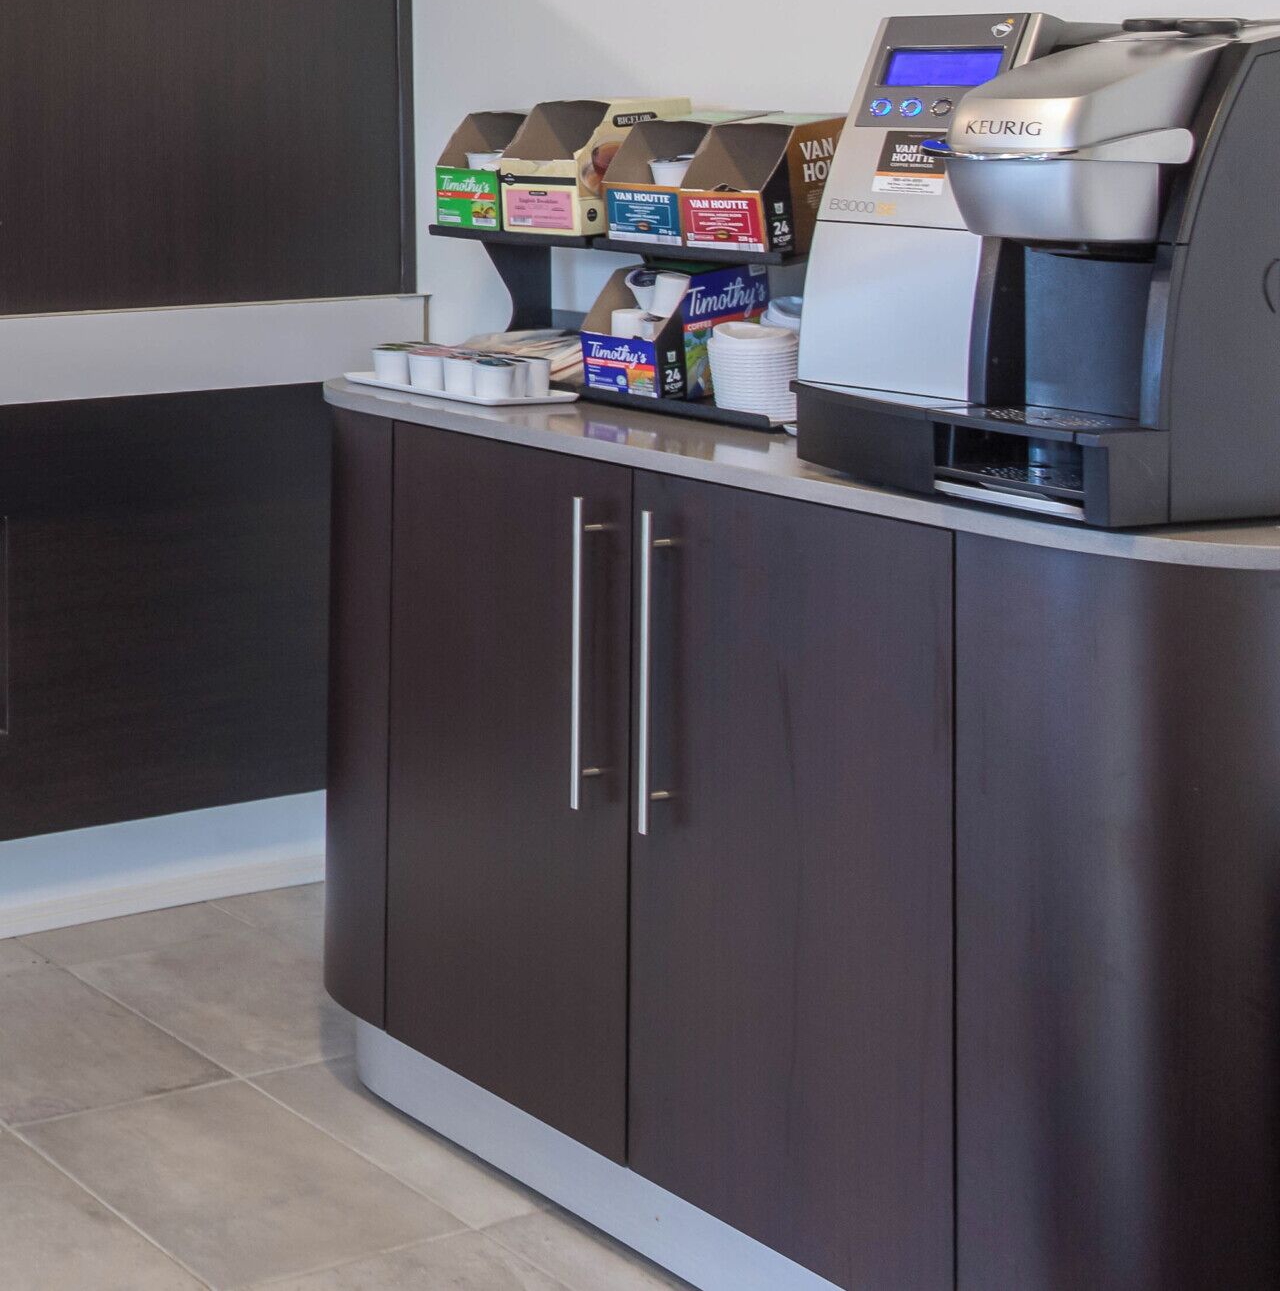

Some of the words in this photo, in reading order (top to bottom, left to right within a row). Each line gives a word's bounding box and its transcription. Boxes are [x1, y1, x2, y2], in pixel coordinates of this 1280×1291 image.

[965, 120, 1043, 137] KEURIG
[799, 137, 835, 160] VAN
[895, 144, 917, 154] VAN
[891, 153, 935, 163] HOUTTE
[802, 159, 832, 183] HO
[440, 175, 490, 199] Timothy's
[613, 191, 633, 201] VAN
[633, 193, 671, 204] HOUTTE
[689, 199, 709, 209] VAN
[710, 200, 749, 210] HOUTTE
[829, 197, 875, 214] B3000
[772, 220, 790, 236] 24
[687, 276, 766, 318] Timothy's
[687, 320, 713, 332] COFFEE
[587, 340, 648, 369] Timothy's
[665, 368, 681, 384] 24
